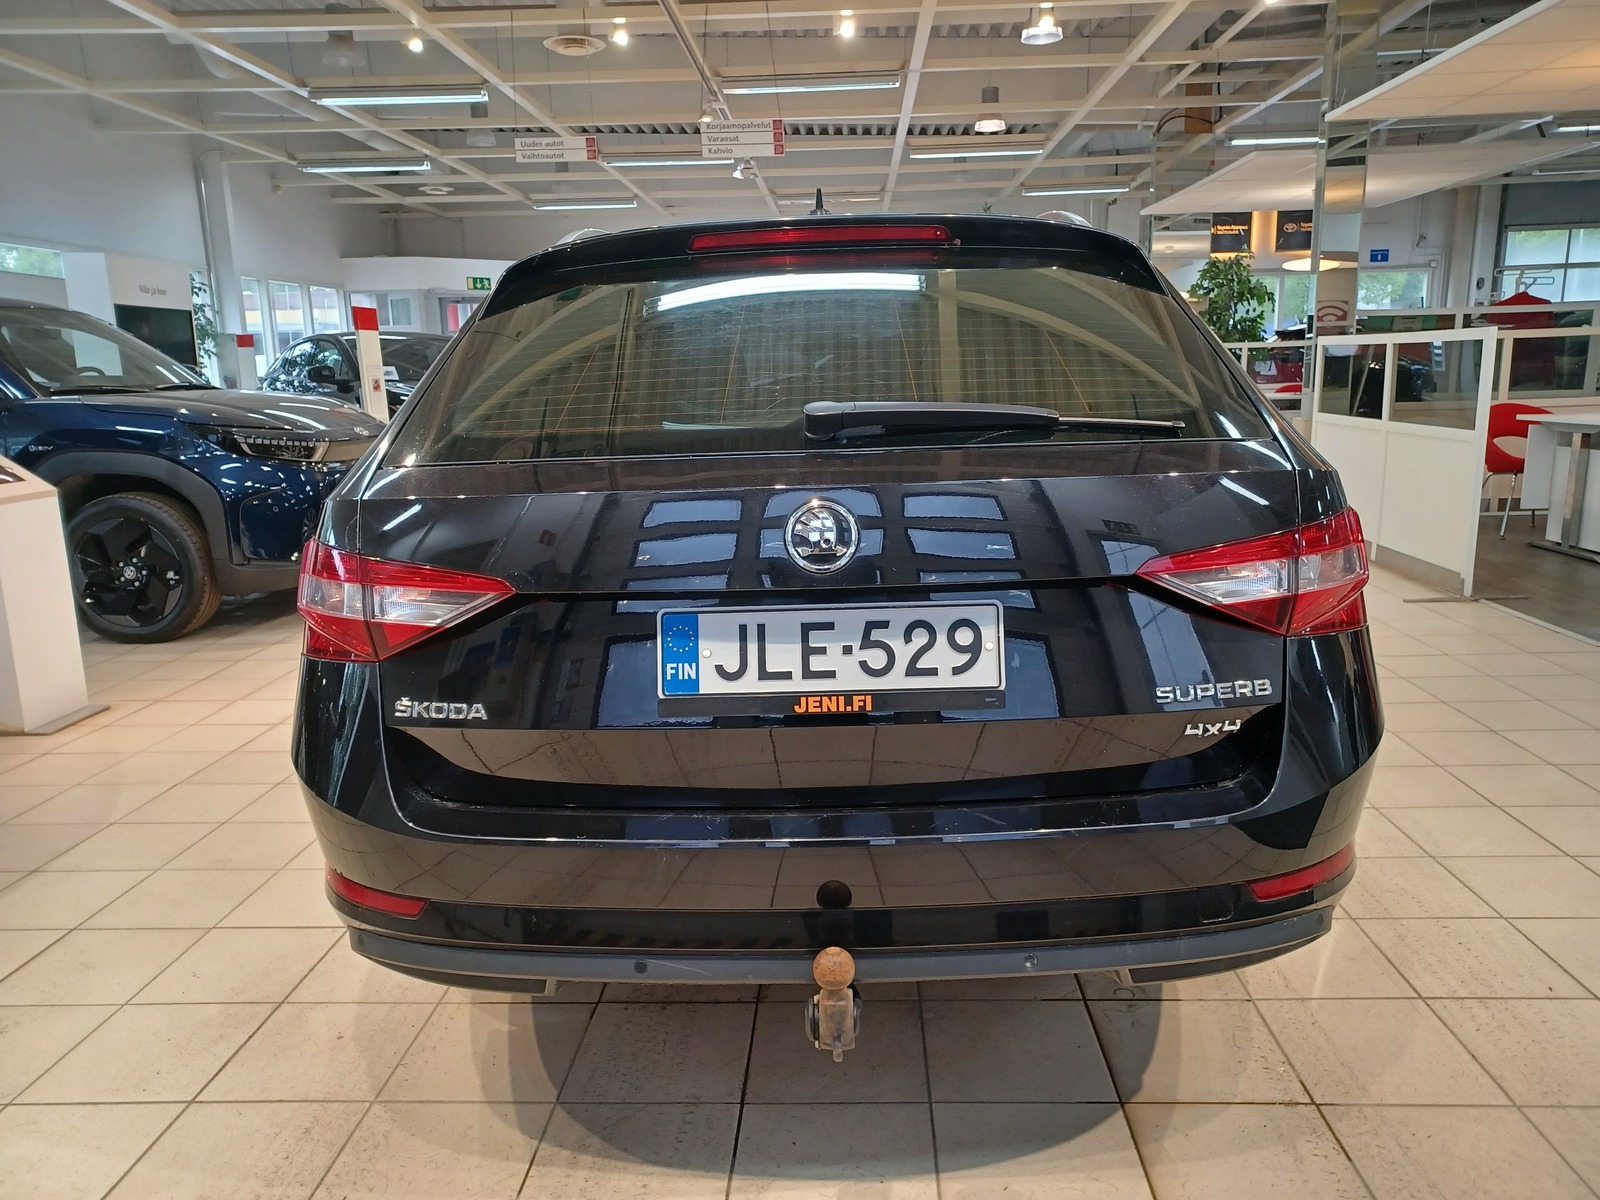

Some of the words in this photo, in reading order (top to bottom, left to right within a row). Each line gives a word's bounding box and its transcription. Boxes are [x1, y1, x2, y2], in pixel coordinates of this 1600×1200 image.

[706, 122, 771, 131] Korjaamopalvelut
[666, 662, 697, 681] FIN
[1155, 679, 1273, 704] SUPERB
[394, 697, 488, 720] ŠKODA
[794, 695, 872, 714] JENI.FI
